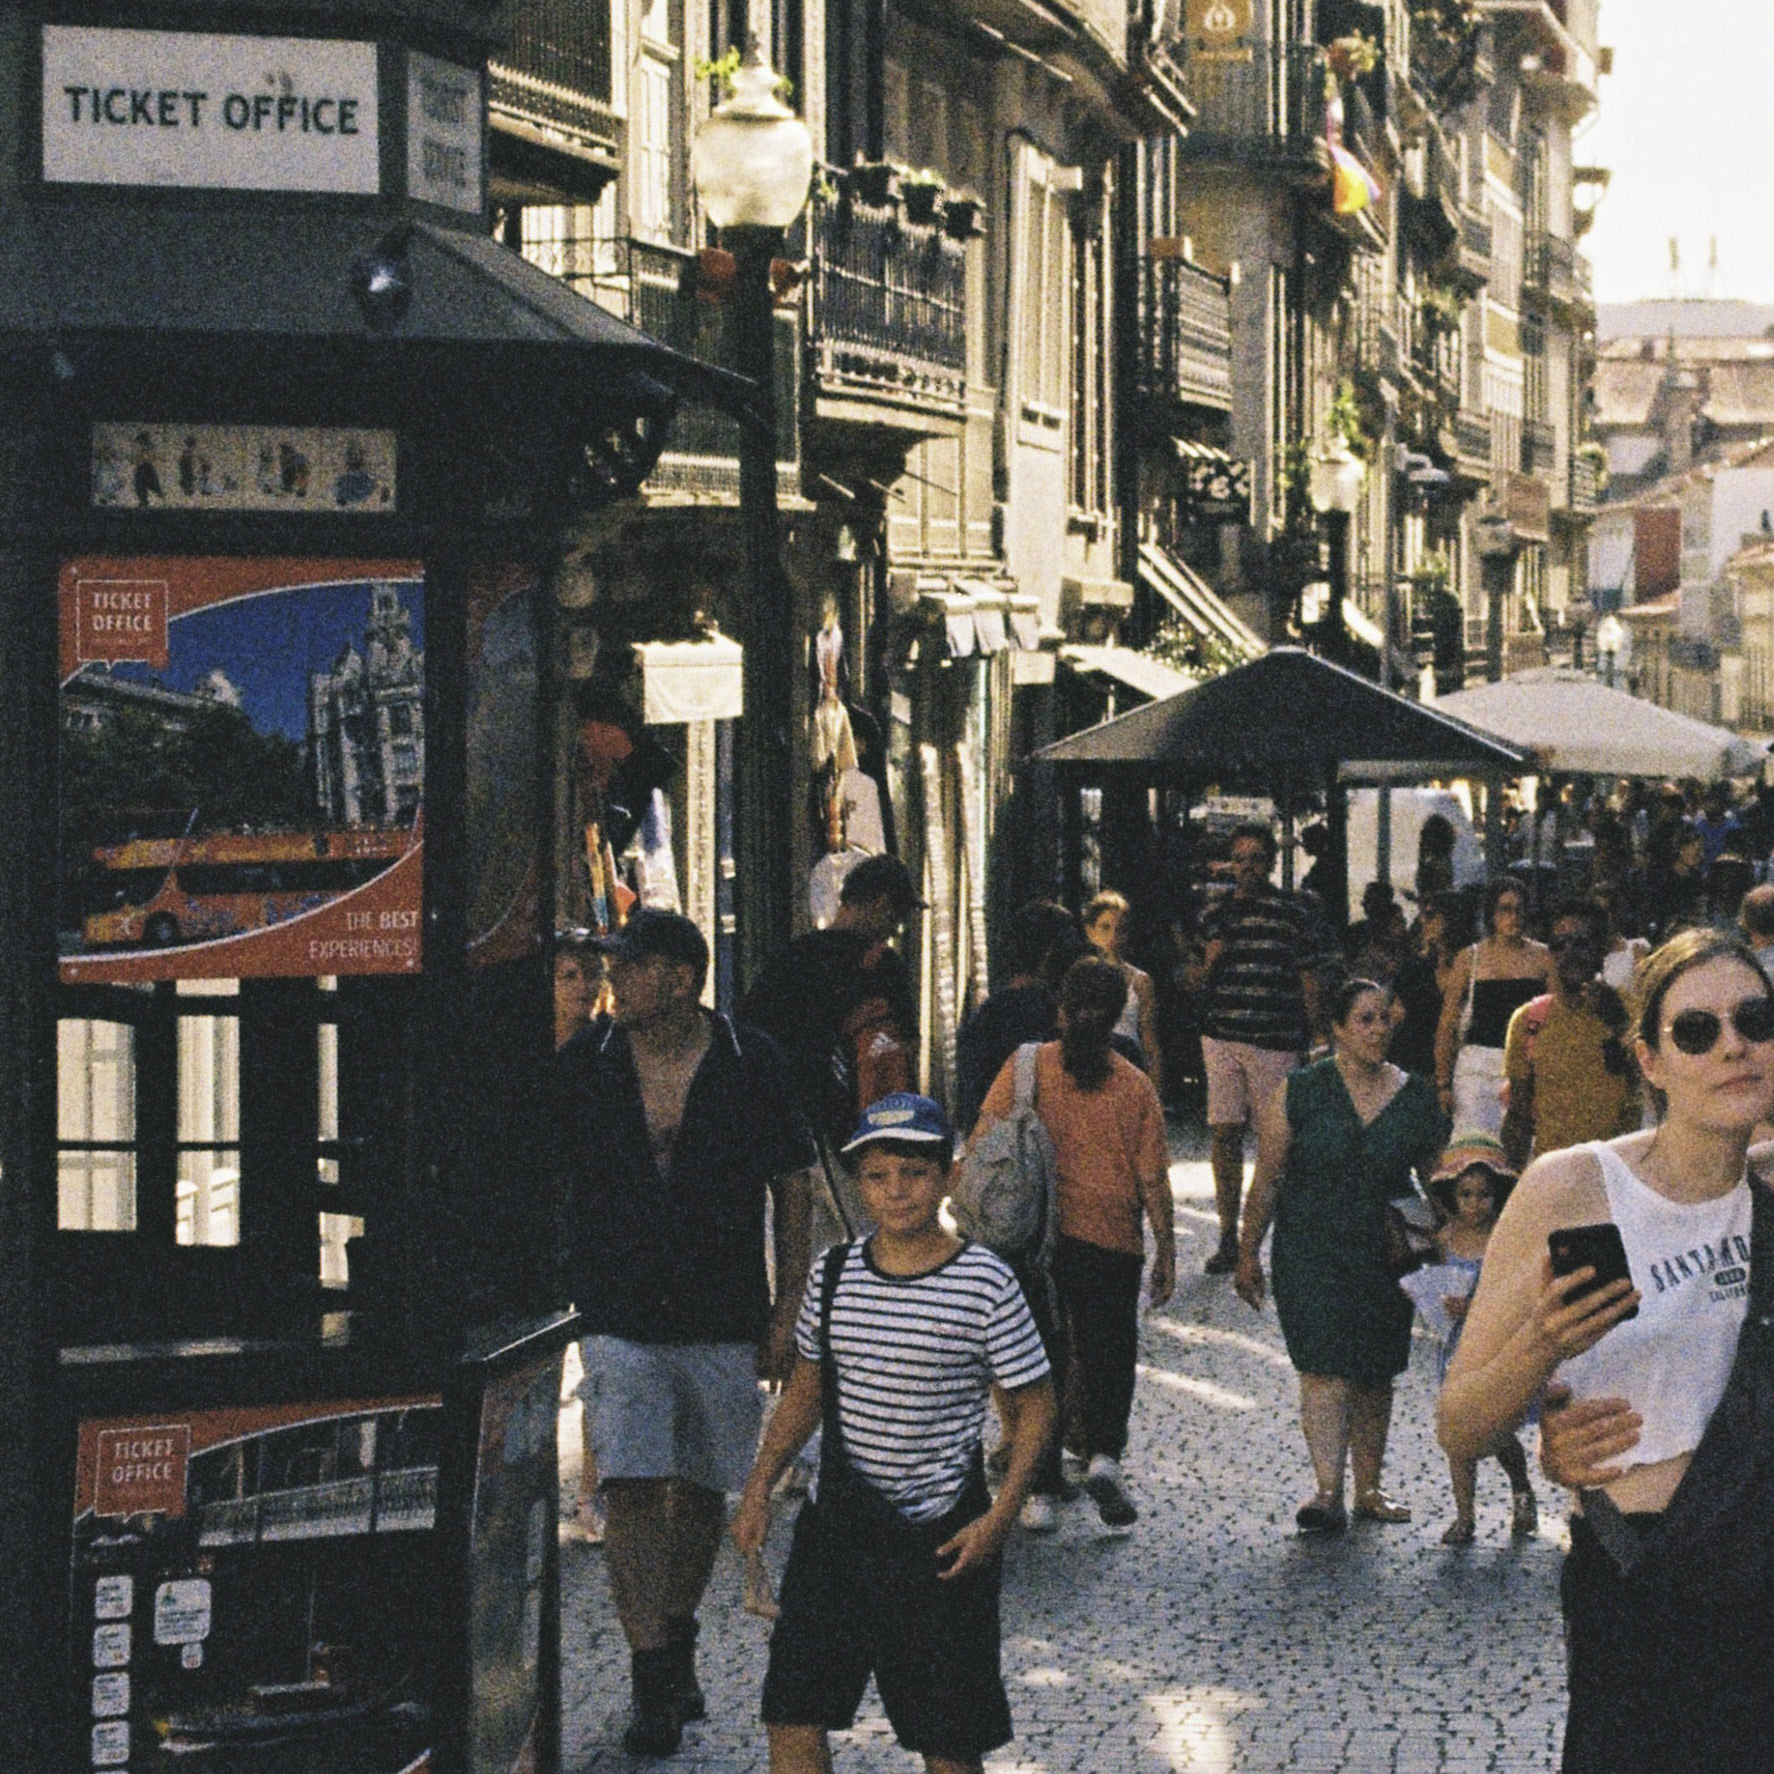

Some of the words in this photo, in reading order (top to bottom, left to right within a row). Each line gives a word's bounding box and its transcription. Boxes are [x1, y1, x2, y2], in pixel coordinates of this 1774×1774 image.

[63, 85, 208, 126] TICKET
[223, 92, 360, 135] OFFICE
[92, 592, 153, 610] TICKET
[92, 614, 152, 632] OFFICE
[346, 910, 374, 931] THE
[379, 910, 418, 930] BEST
[1650, 1243, 1716, 1293] SANTA
[115, 1438, 174, 1459] TICKET
[111, 1461, 173, 1483] OFFICE
